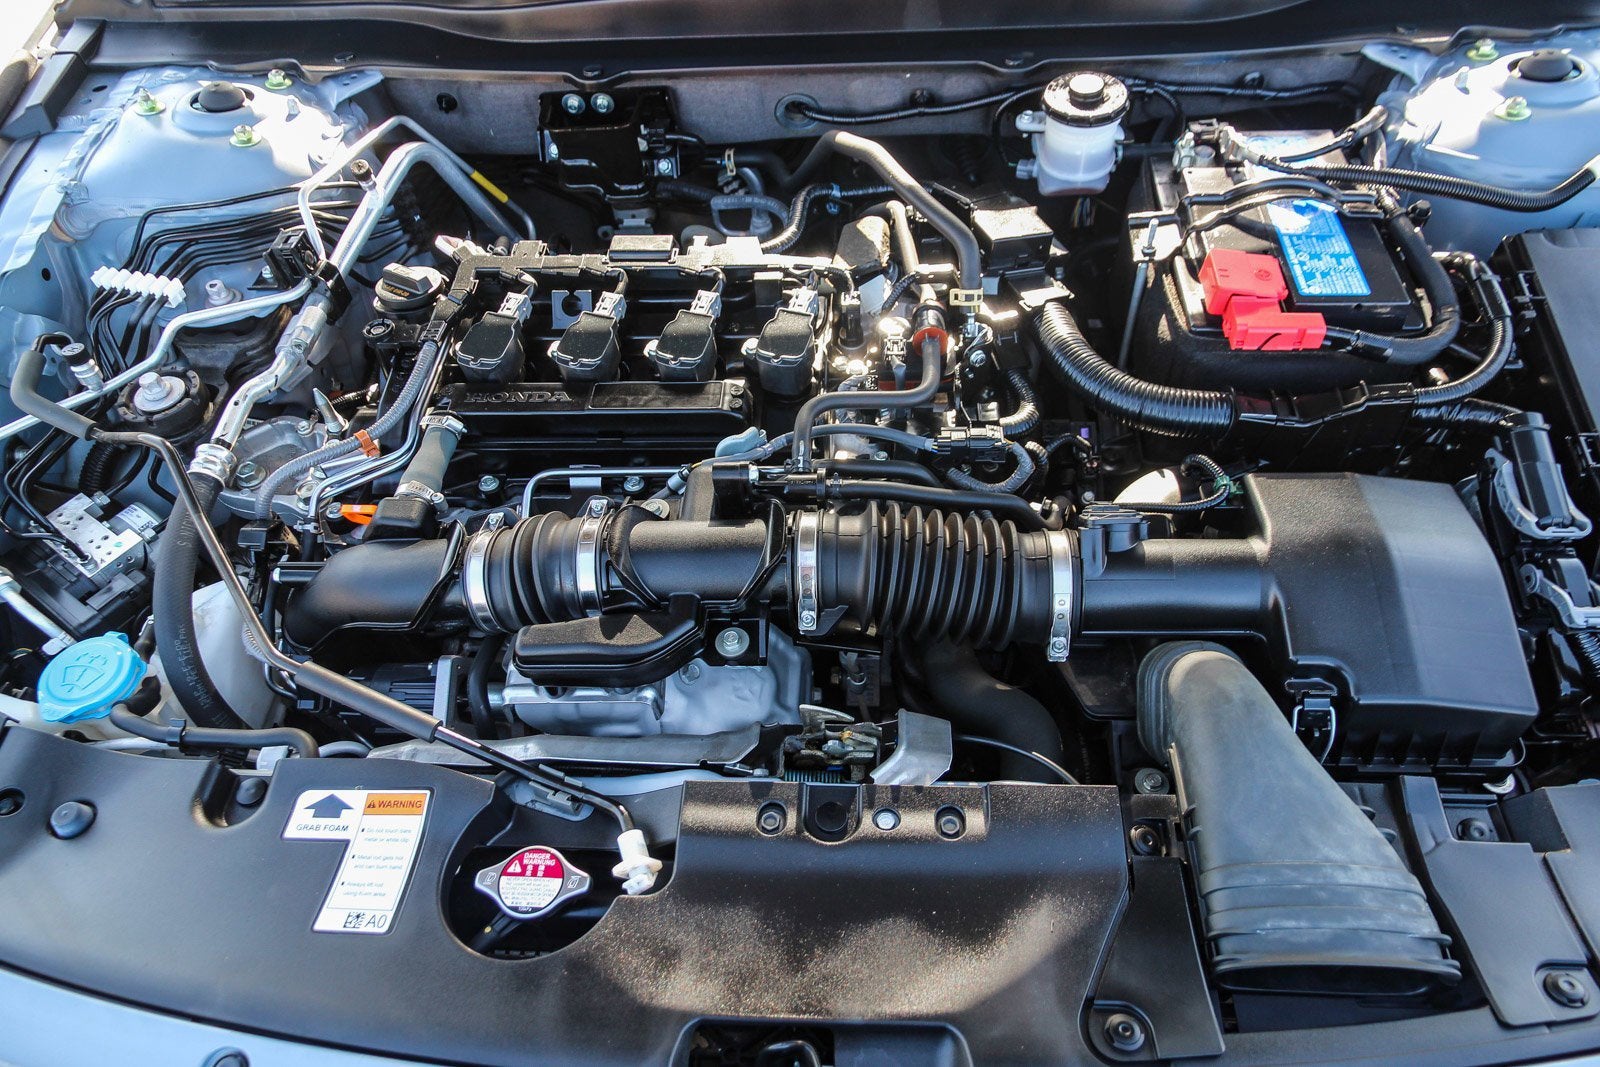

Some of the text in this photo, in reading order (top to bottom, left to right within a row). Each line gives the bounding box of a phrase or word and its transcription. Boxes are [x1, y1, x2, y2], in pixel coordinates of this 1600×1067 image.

[463, 391, 573, 403] HONDA
[377, 800, 423, 808] WARNING
[296, 824, 349, 832] GRAB FOAM
[524, 852, 551, 860] DANGER
[523, 858, 556, 866] WARNUNG
